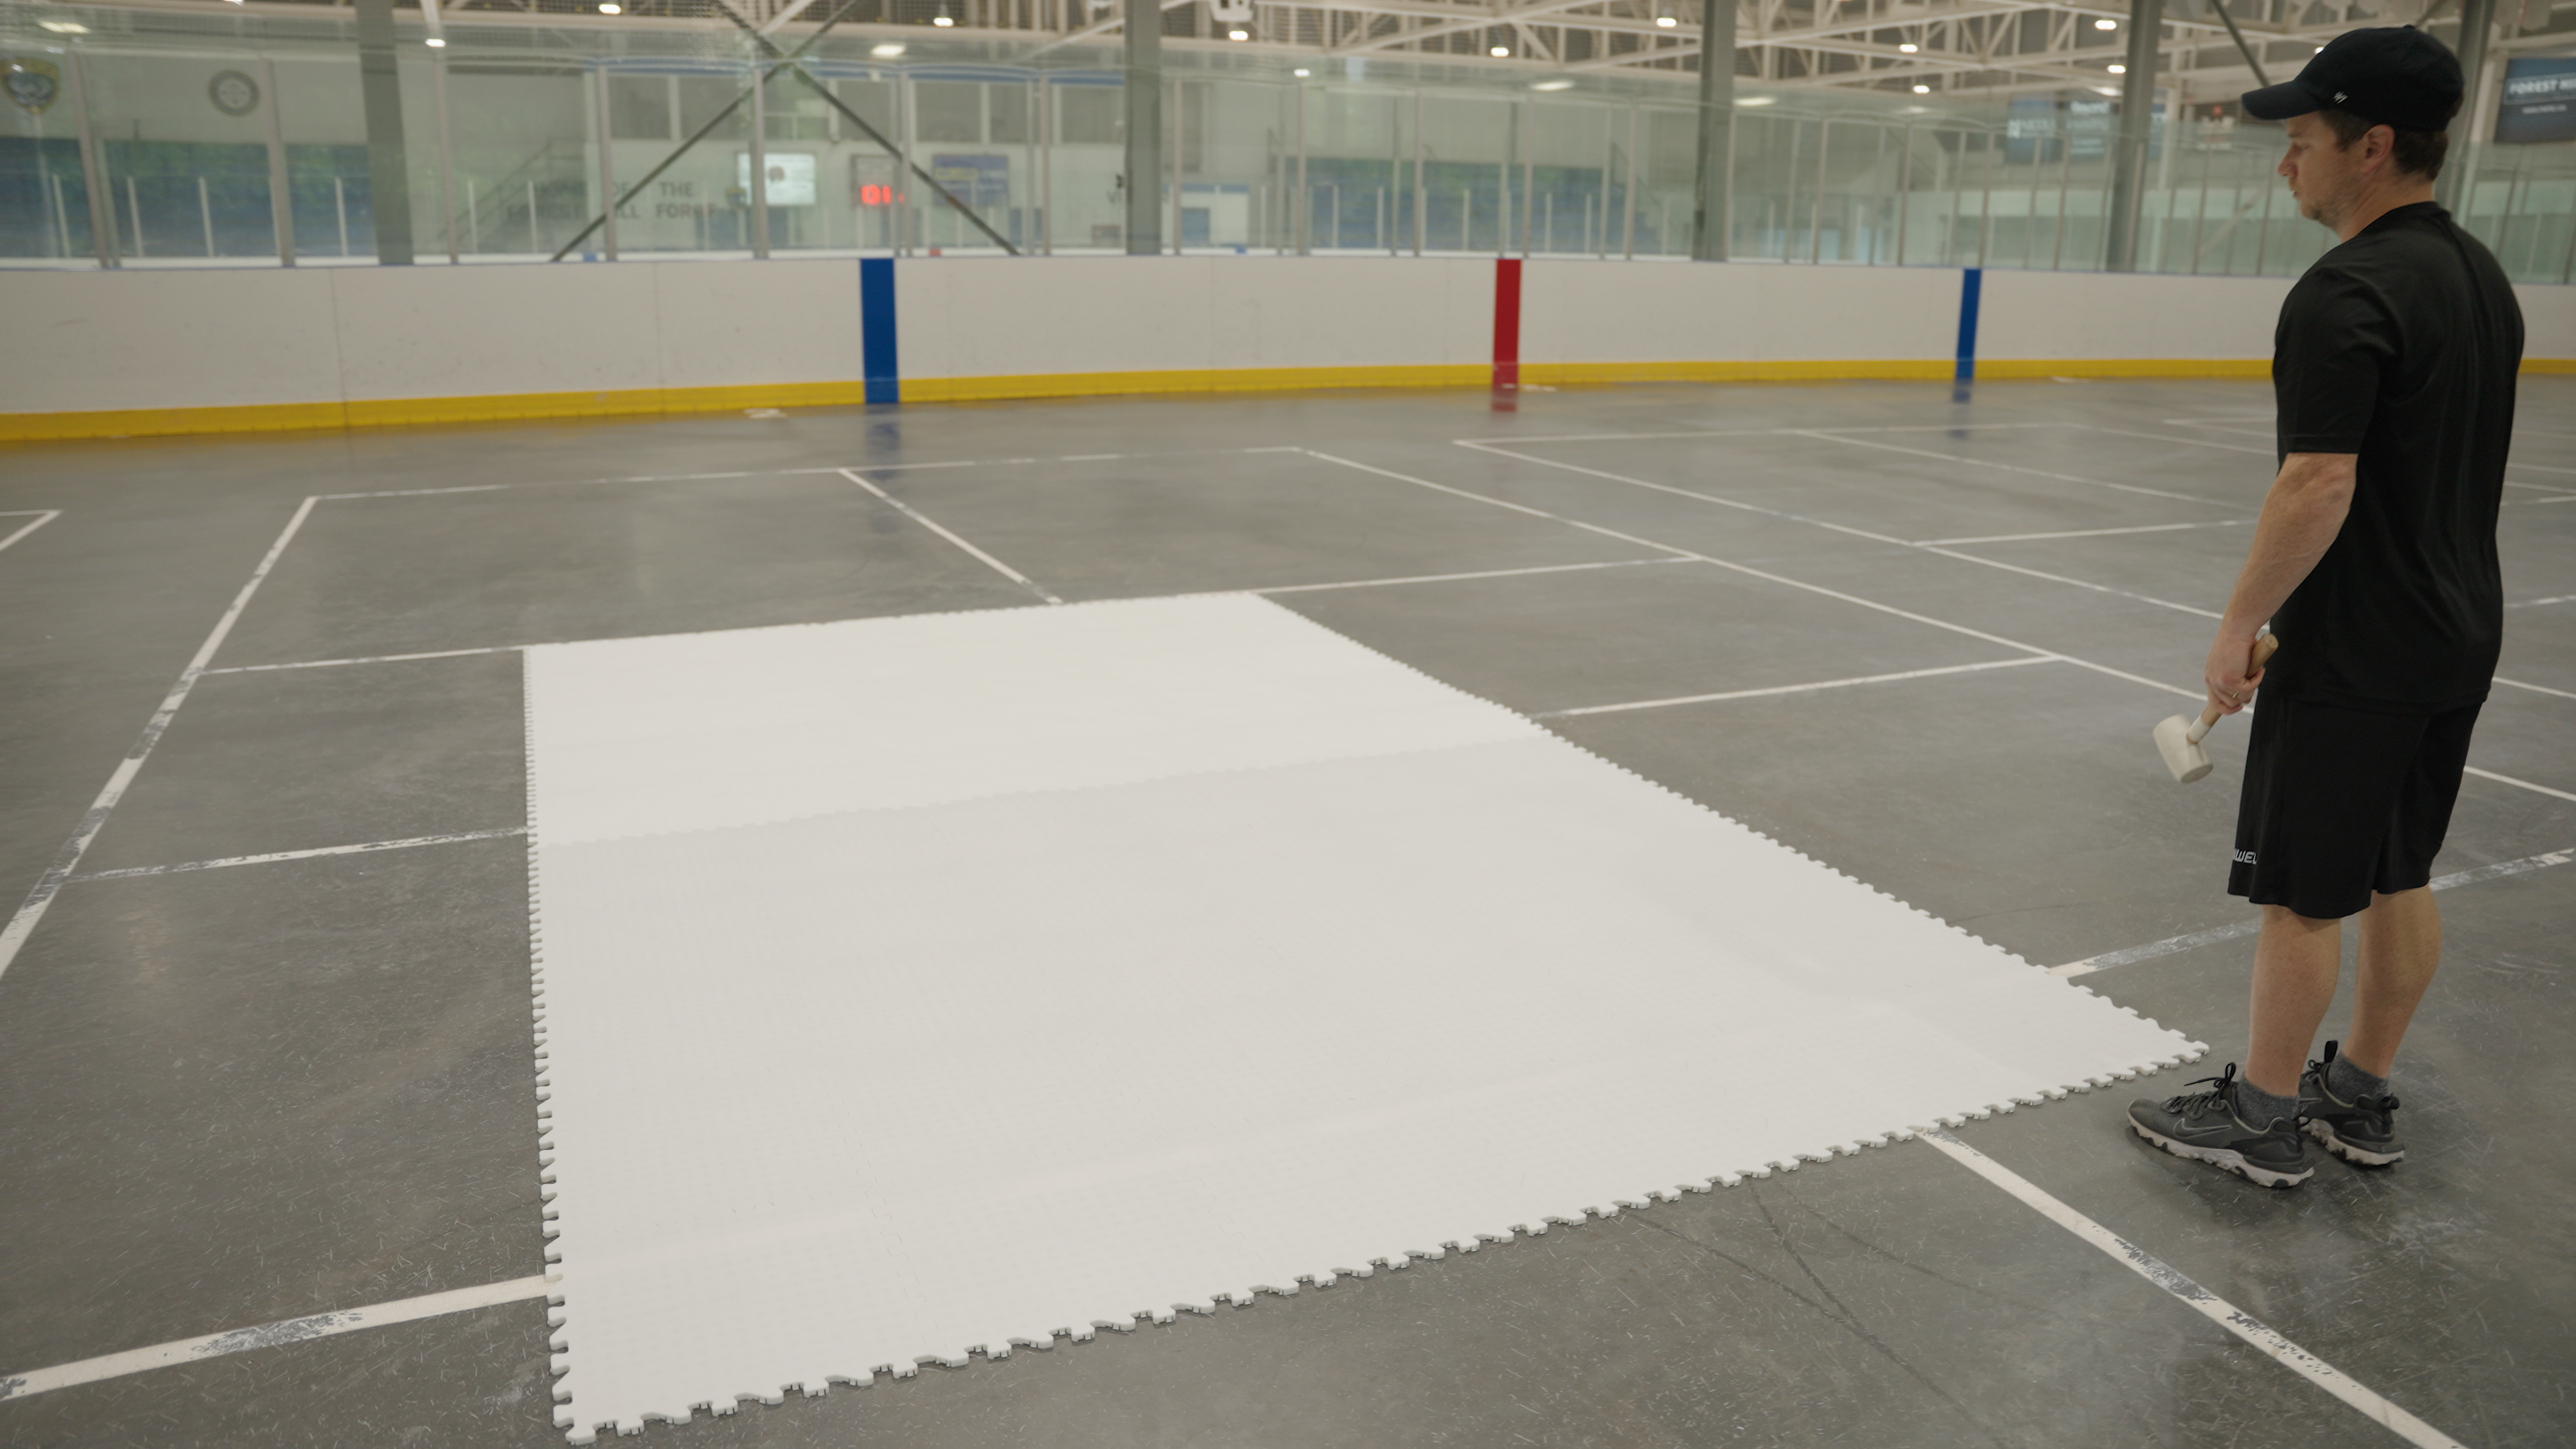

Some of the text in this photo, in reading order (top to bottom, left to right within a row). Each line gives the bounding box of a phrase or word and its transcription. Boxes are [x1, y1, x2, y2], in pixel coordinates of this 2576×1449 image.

[2510, 80, 2558, 95] FOREST
[658, 181, 694, 198] THE
[2234, 849, 2257, 865] WEL
